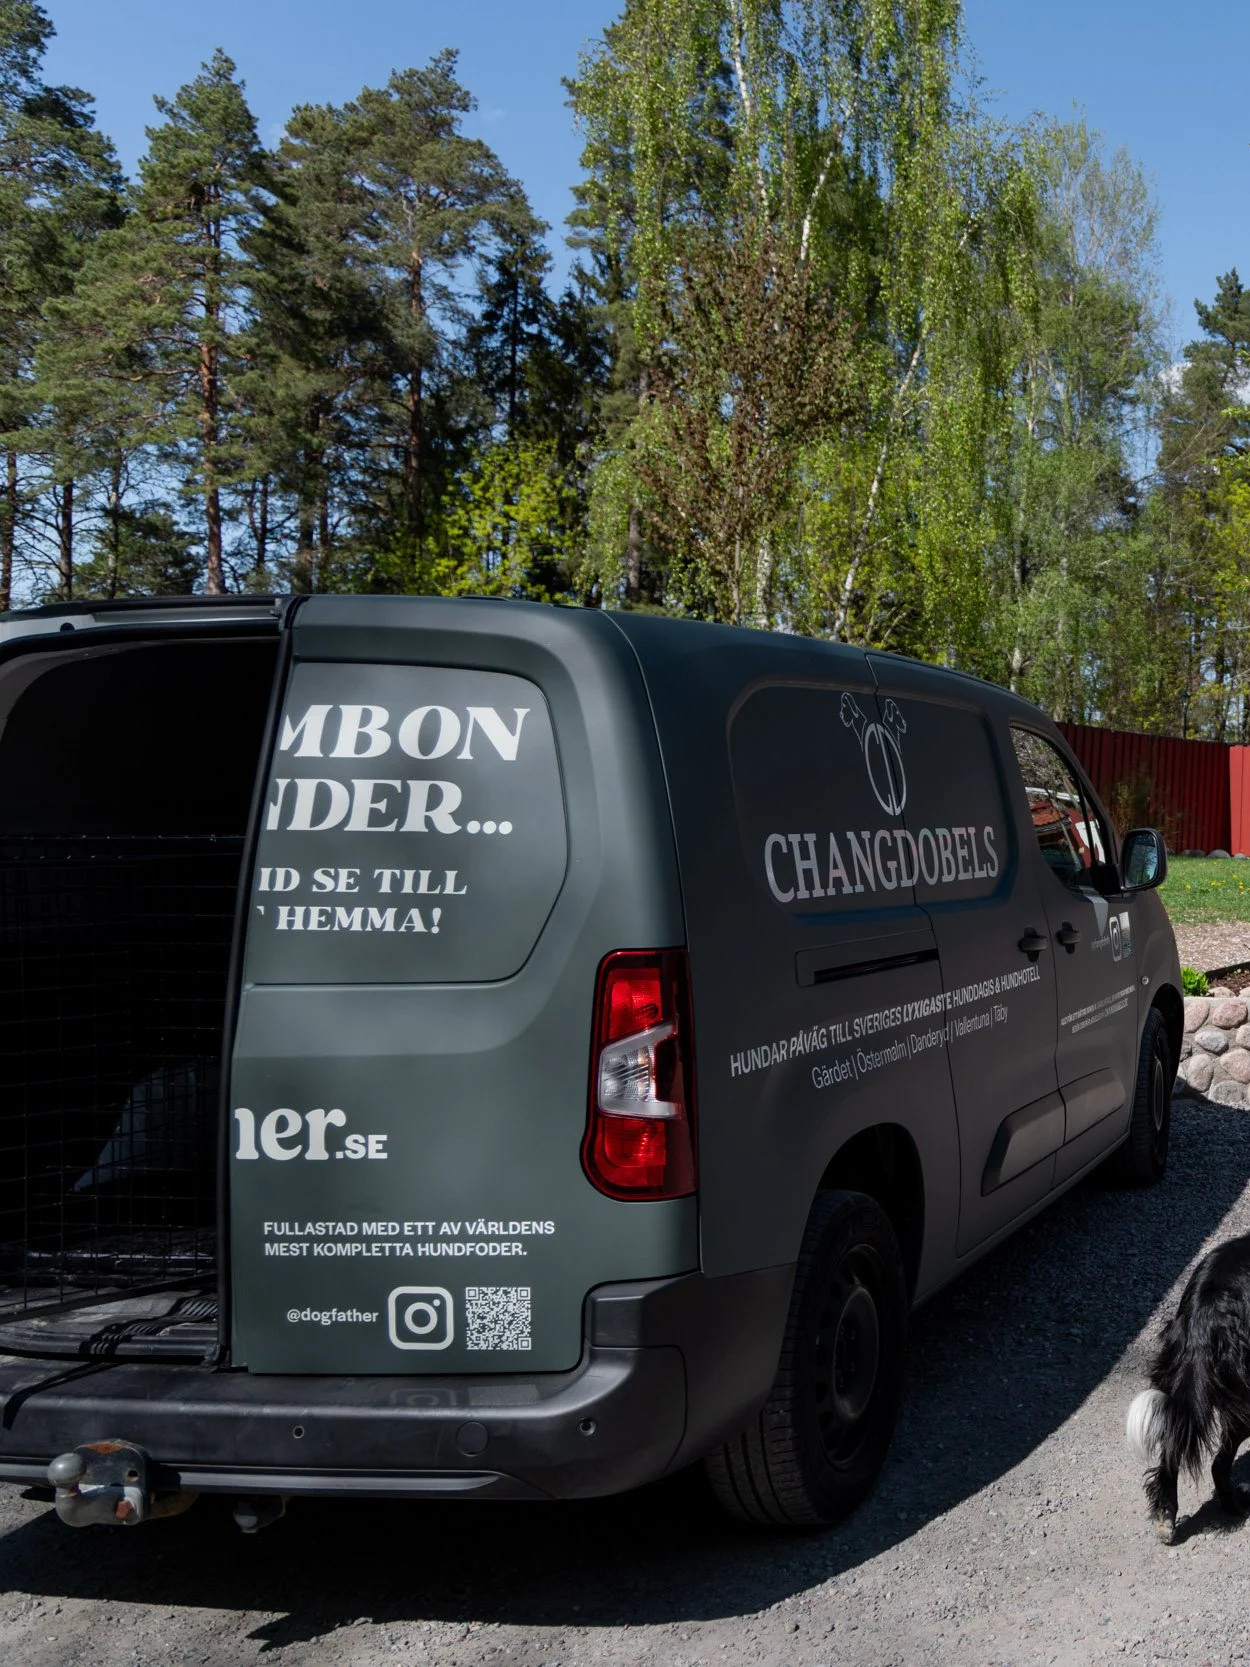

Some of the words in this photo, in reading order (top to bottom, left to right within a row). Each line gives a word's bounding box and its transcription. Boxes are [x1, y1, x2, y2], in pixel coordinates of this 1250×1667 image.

[764, 826, 998, 903] CHANGDOBELS
[312, 868, 360, 892] SE
[373, 869, 467, 895] TILL
[276, 906, 442, 934] HEMMA!
[731, 1039, 787, 1076] HUNDAR
[829, 1021, 853, 1045] TILL
[853, 1007, 902, 1038] SVERIGES
[903, 992, 951, 1023] LYXIGASTE
[953, 976, 995, 1007] HUNDDAGIS
[995, 976, 1001, 993] &
[1000, 964, 1041, 992] HUNDHOTELL
[811, 1060, 852, 1089] Gärdet
[857, 1042, 906, 1072] Östermalm
[911, 1027, 949, 1055] Danderyd
[954, 1011, 990, 1038] Vallentuna
[994, 1003, 1008, 1023] Täby
[264, 1222, 358, 1235] FULLASTAD
[362, 1222, 400, 1235] MED
[404, 1222, 436, 1235] ETT
[439, 1222, 460, 1235] AV
[465, 1219, 555, 1235] VÄRLDENS
[265, 1243, 309, 1256] MEST
[313, 1243, 413, 1256] KOMPLETTA
[417, 1243, 527, 1256] HUNDFODER.
[286, 1308, 379, 1325] @dogfather
